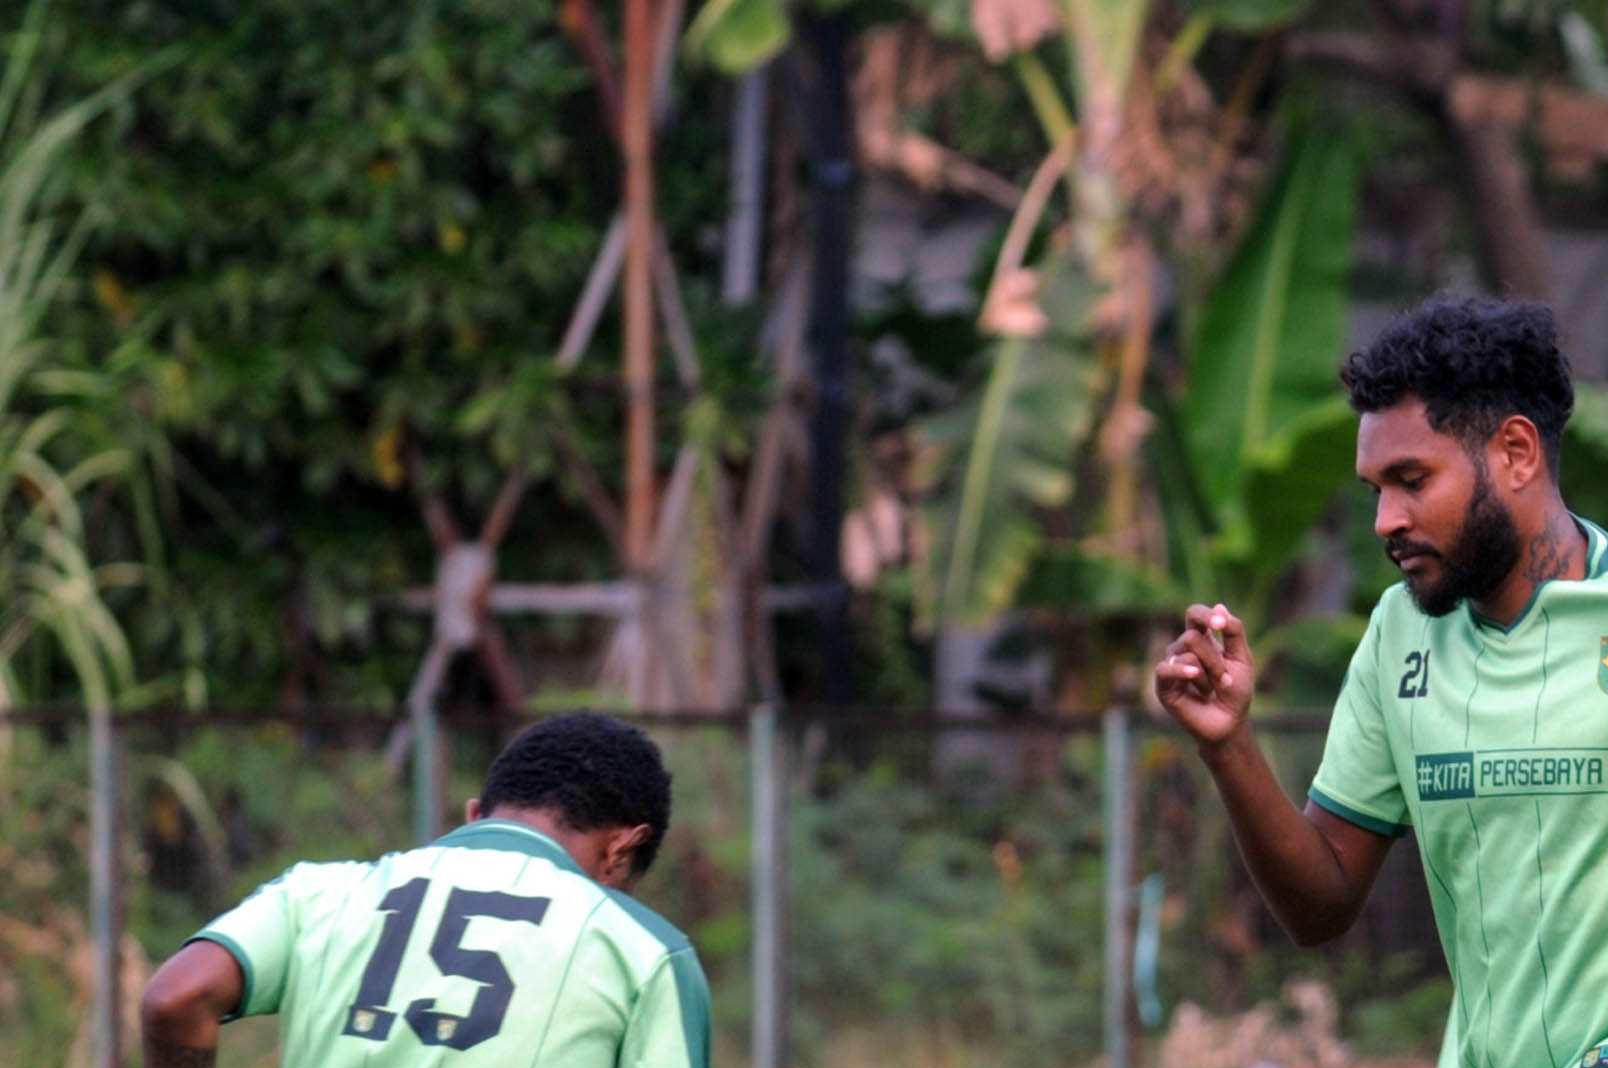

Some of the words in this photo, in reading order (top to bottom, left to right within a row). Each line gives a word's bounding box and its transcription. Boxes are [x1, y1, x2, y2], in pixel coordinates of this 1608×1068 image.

[1398, 648, 1431, 698] 21
[1417, 759, 1471, 793] #KITA
[1480, 757, 1603, 788] PERSEBAYA
[342, 876, 553, 1052] 15
